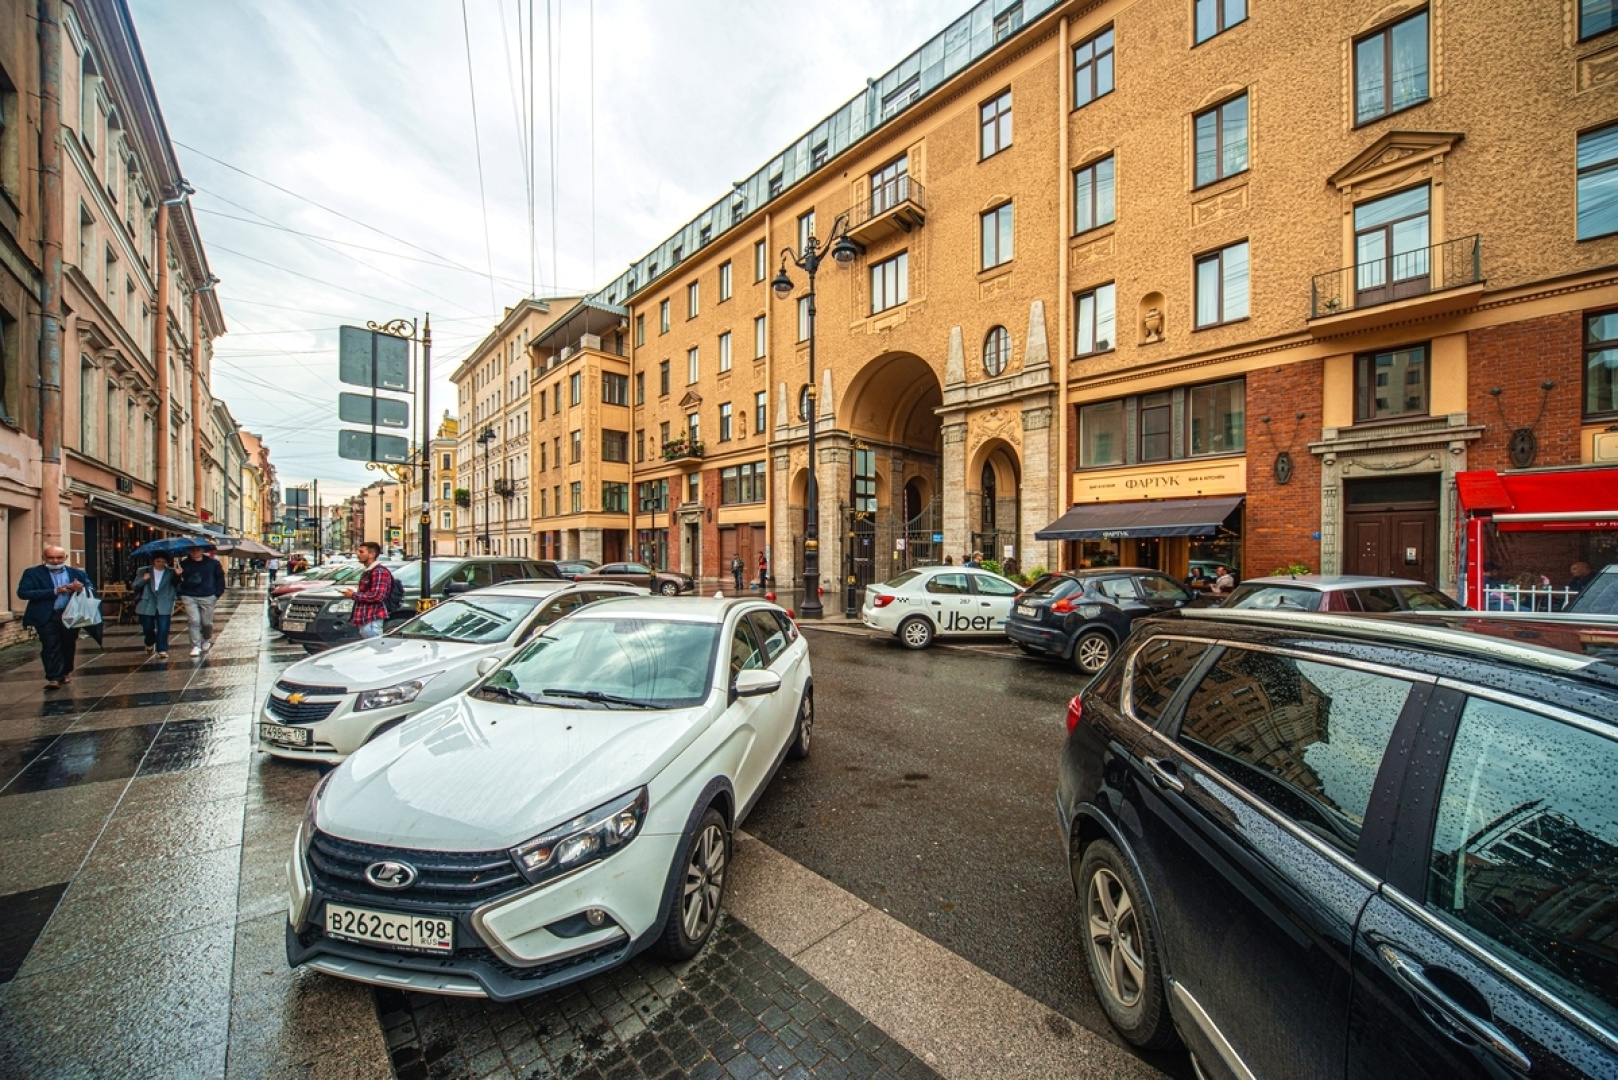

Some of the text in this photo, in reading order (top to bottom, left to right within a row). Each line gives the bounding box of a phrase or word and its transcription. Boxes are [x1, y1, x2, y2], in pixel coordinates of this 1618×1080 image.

[1125, 476, 1180, 489] ФАРТУК
[937, 610, 995, 631] Uber
[414, 919, 446, 938] 198
[420, 937, 438, 946] RUS
